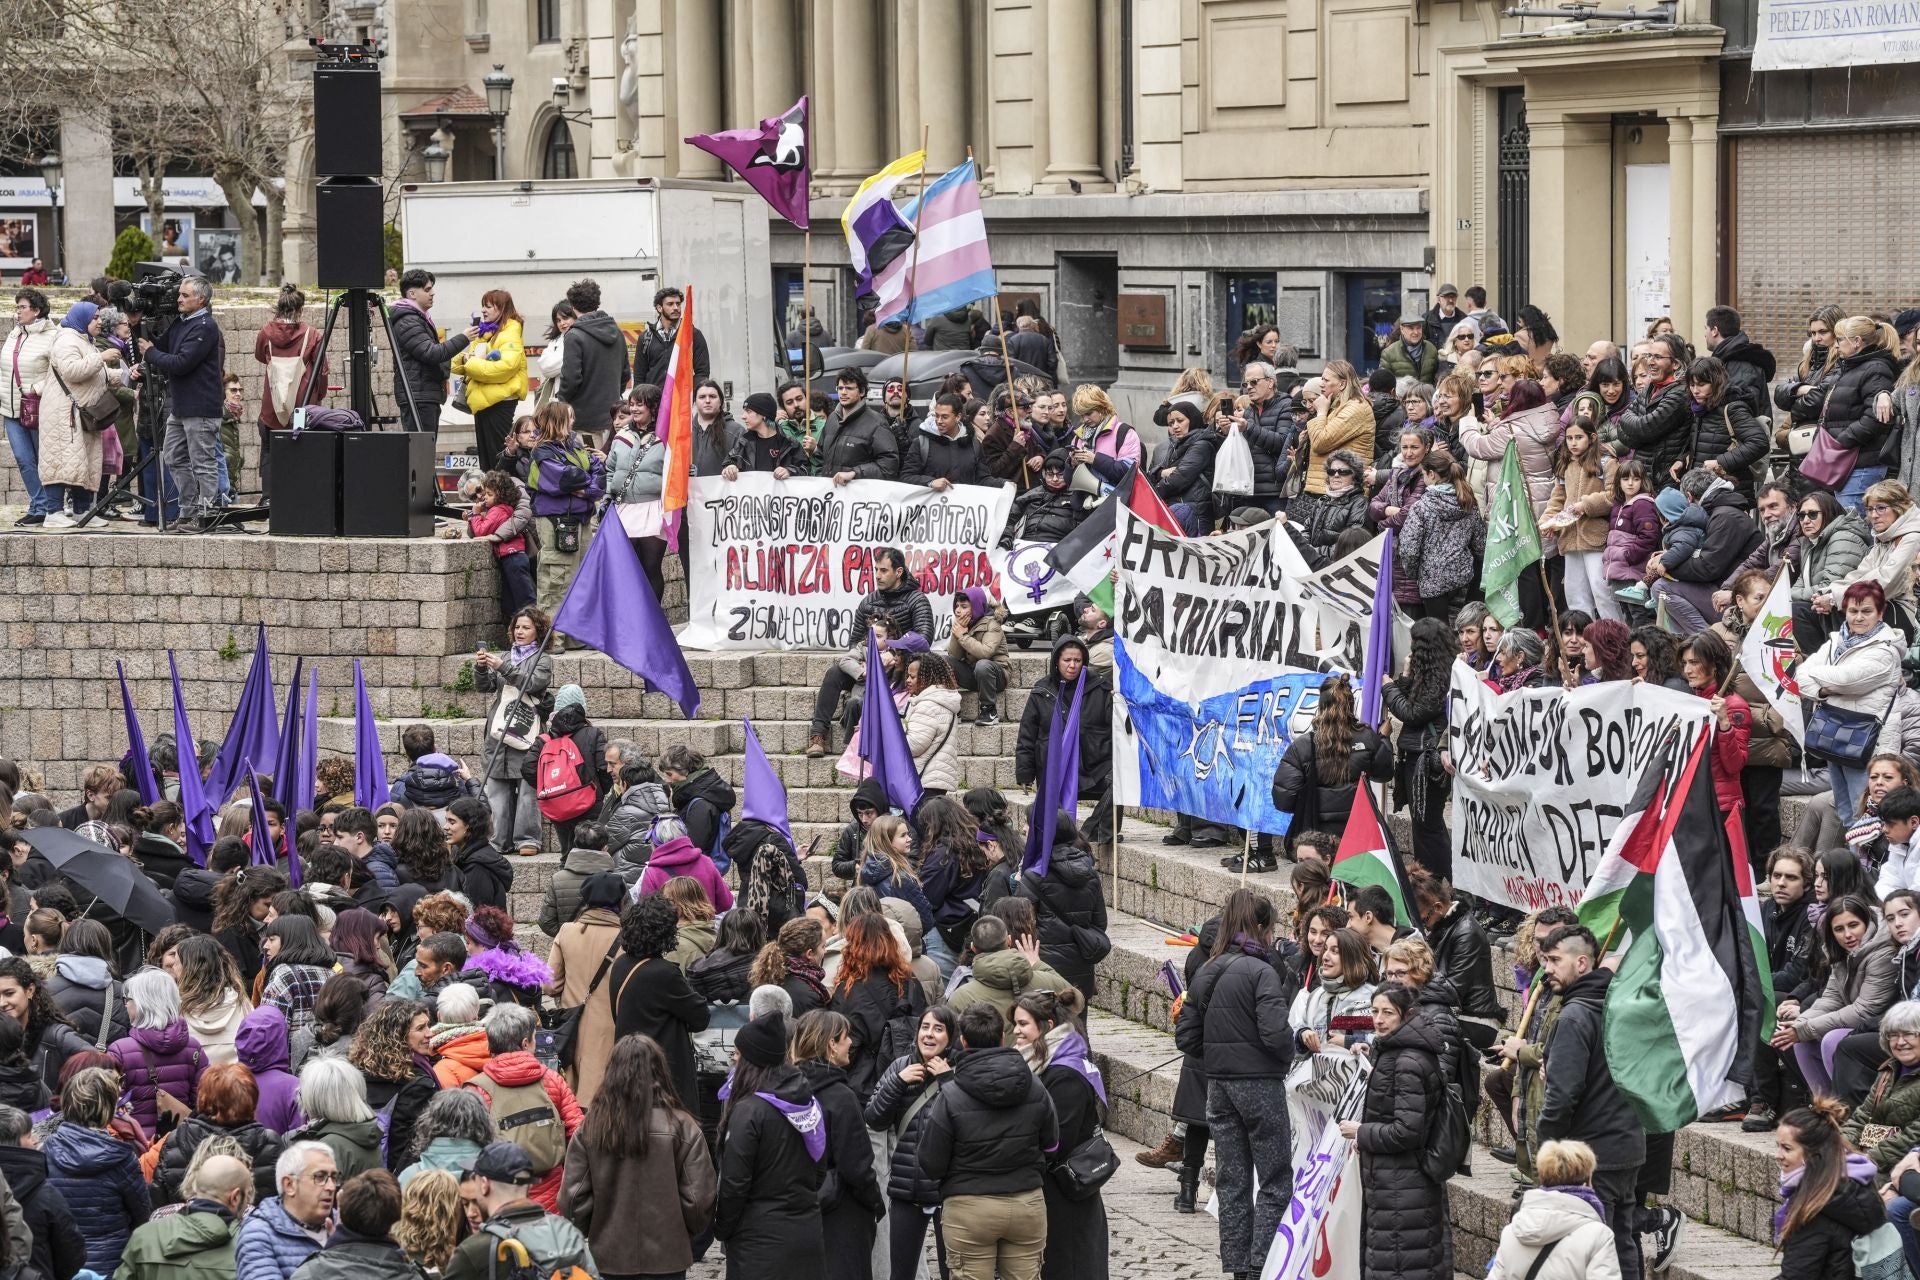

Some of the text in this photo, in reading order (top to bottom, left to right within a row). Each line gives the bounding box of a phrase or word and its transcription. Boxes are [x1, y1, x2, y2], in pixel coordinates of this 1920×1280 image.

[1769, 11, 1811, 33] PEREZ
[1813, 9, 1831, 31] DE
[1832, 6, 1864, 29] SAN
[453, 457, 478, 467] 2842
[704, 491, 843, 547] TRANSFOBIA
[848, 501, 894, 543] ETA
[725, 540, 831, 596] ALIANTZA
